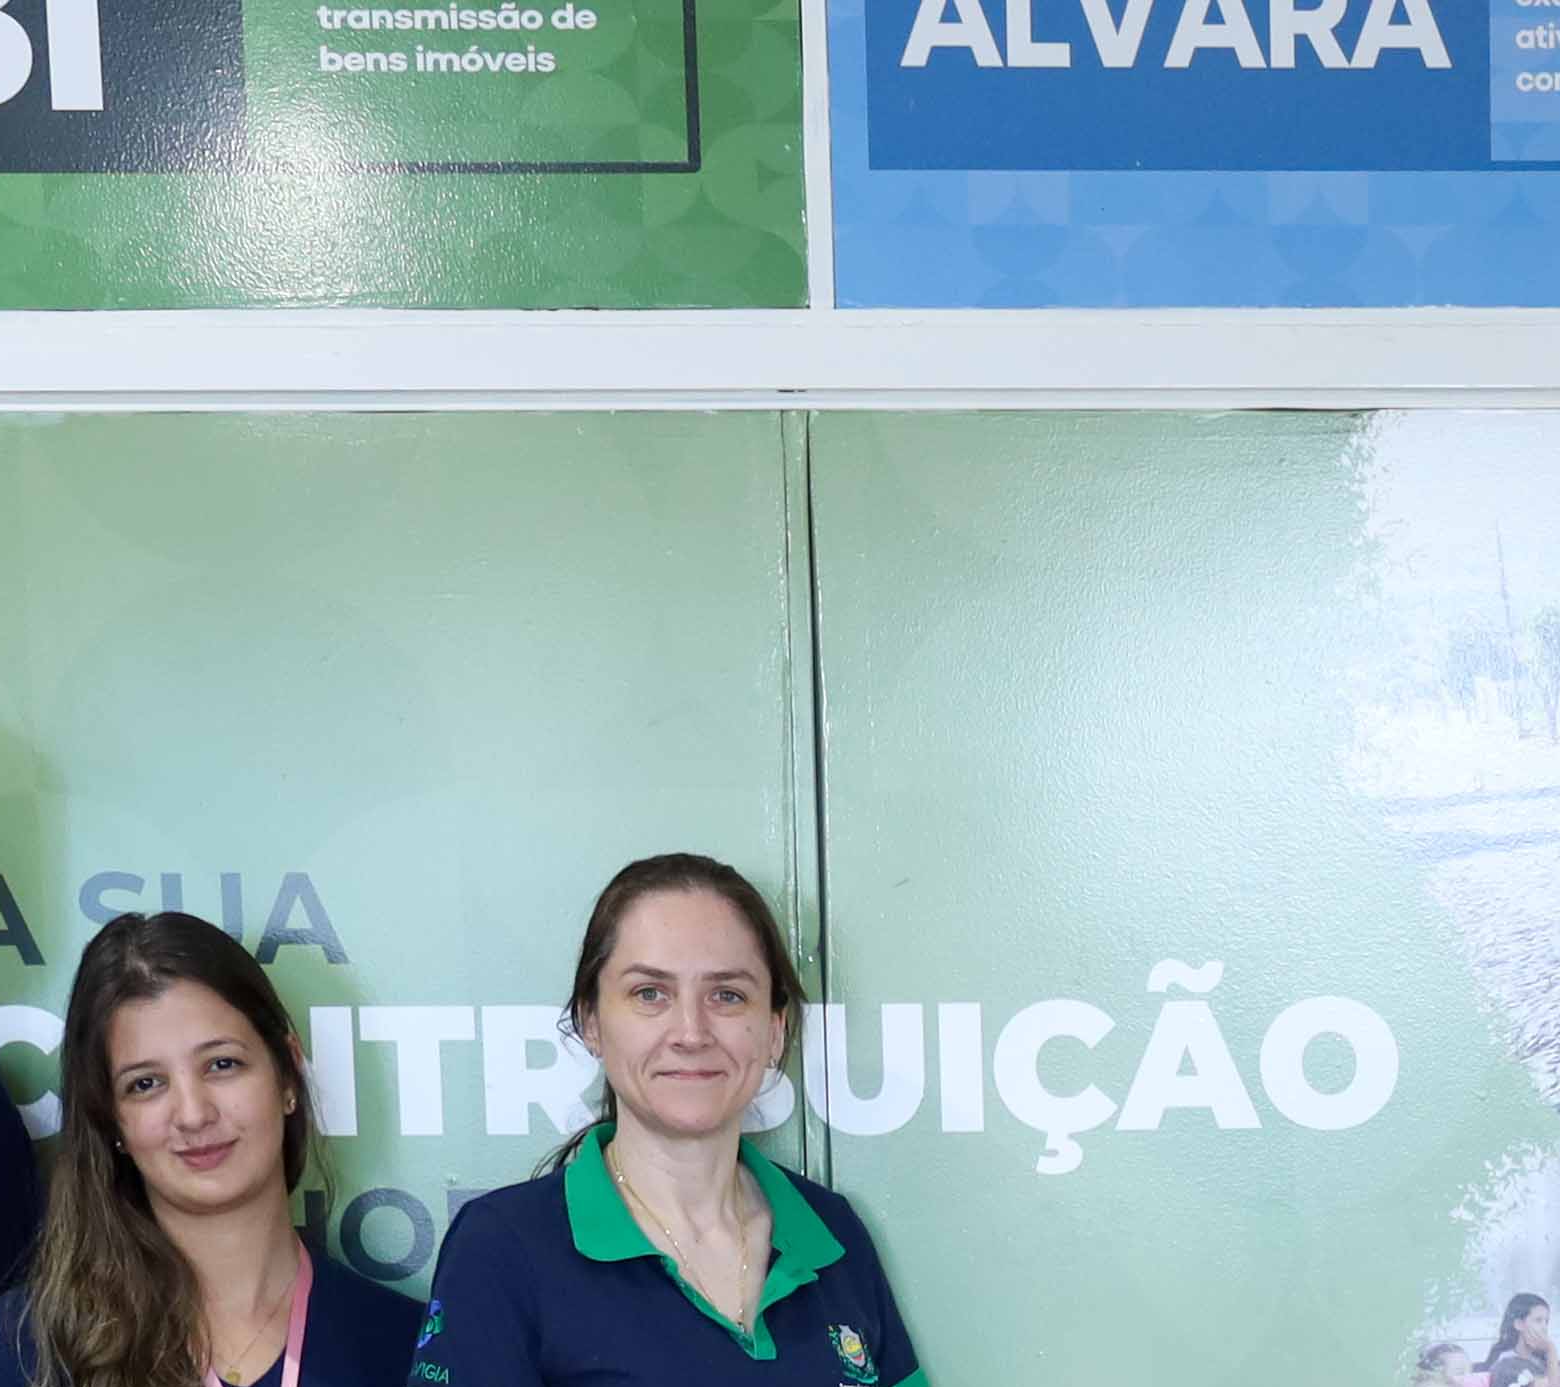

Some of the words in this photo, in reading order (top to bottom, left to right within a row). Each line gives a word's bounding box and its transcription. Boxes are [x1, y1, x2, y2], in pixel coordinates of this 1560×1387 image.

[317, 2, 543, 30] transmissão
[551, 2, 598, 30] de
[319, 45, 408, 73] bens
[416, 45, 557, 73] imóveis
